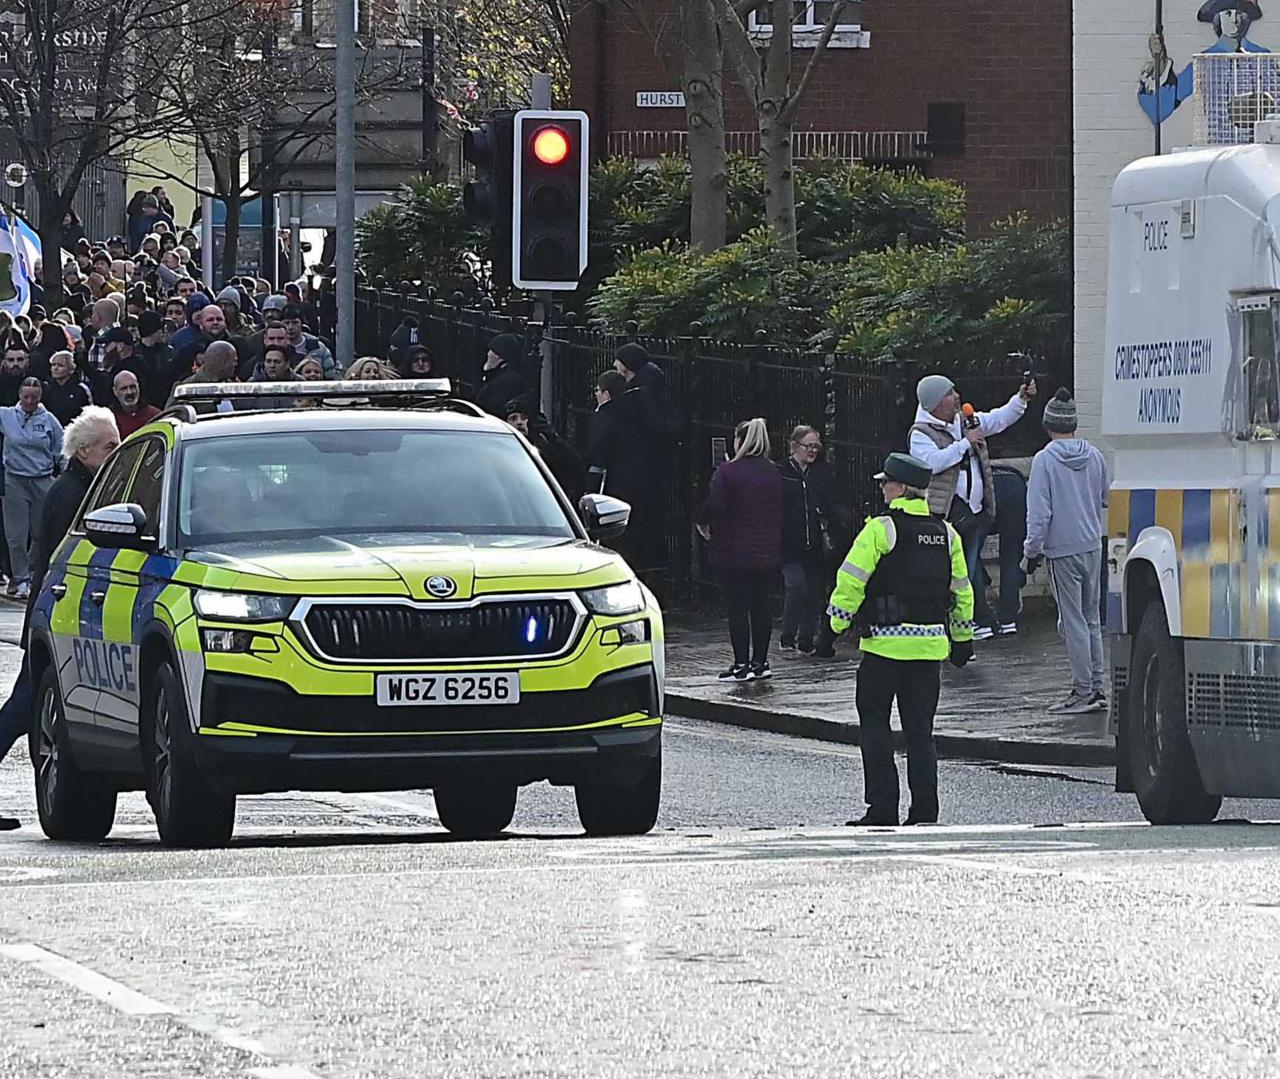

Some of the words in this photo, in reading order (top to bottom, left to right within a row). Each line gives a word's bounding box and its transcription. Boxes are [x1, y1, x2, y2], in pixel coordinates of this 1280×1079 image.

[640, 94, 681, 105] HURST
[1143, 220, 1169, 251] POLICE
[1114, 340, 1173, 380] CRIMESTOPPERS
[1189, 338, 1212, 375] 555111
[1137, 388, 1182, 424] ANONYMOUS
[918, 534, 946, 545] POLICE
[73, 638, 136, 692] POLICE
[388, 678, 436, 701] WGZ
[444, 676, 509, 701] 6256
